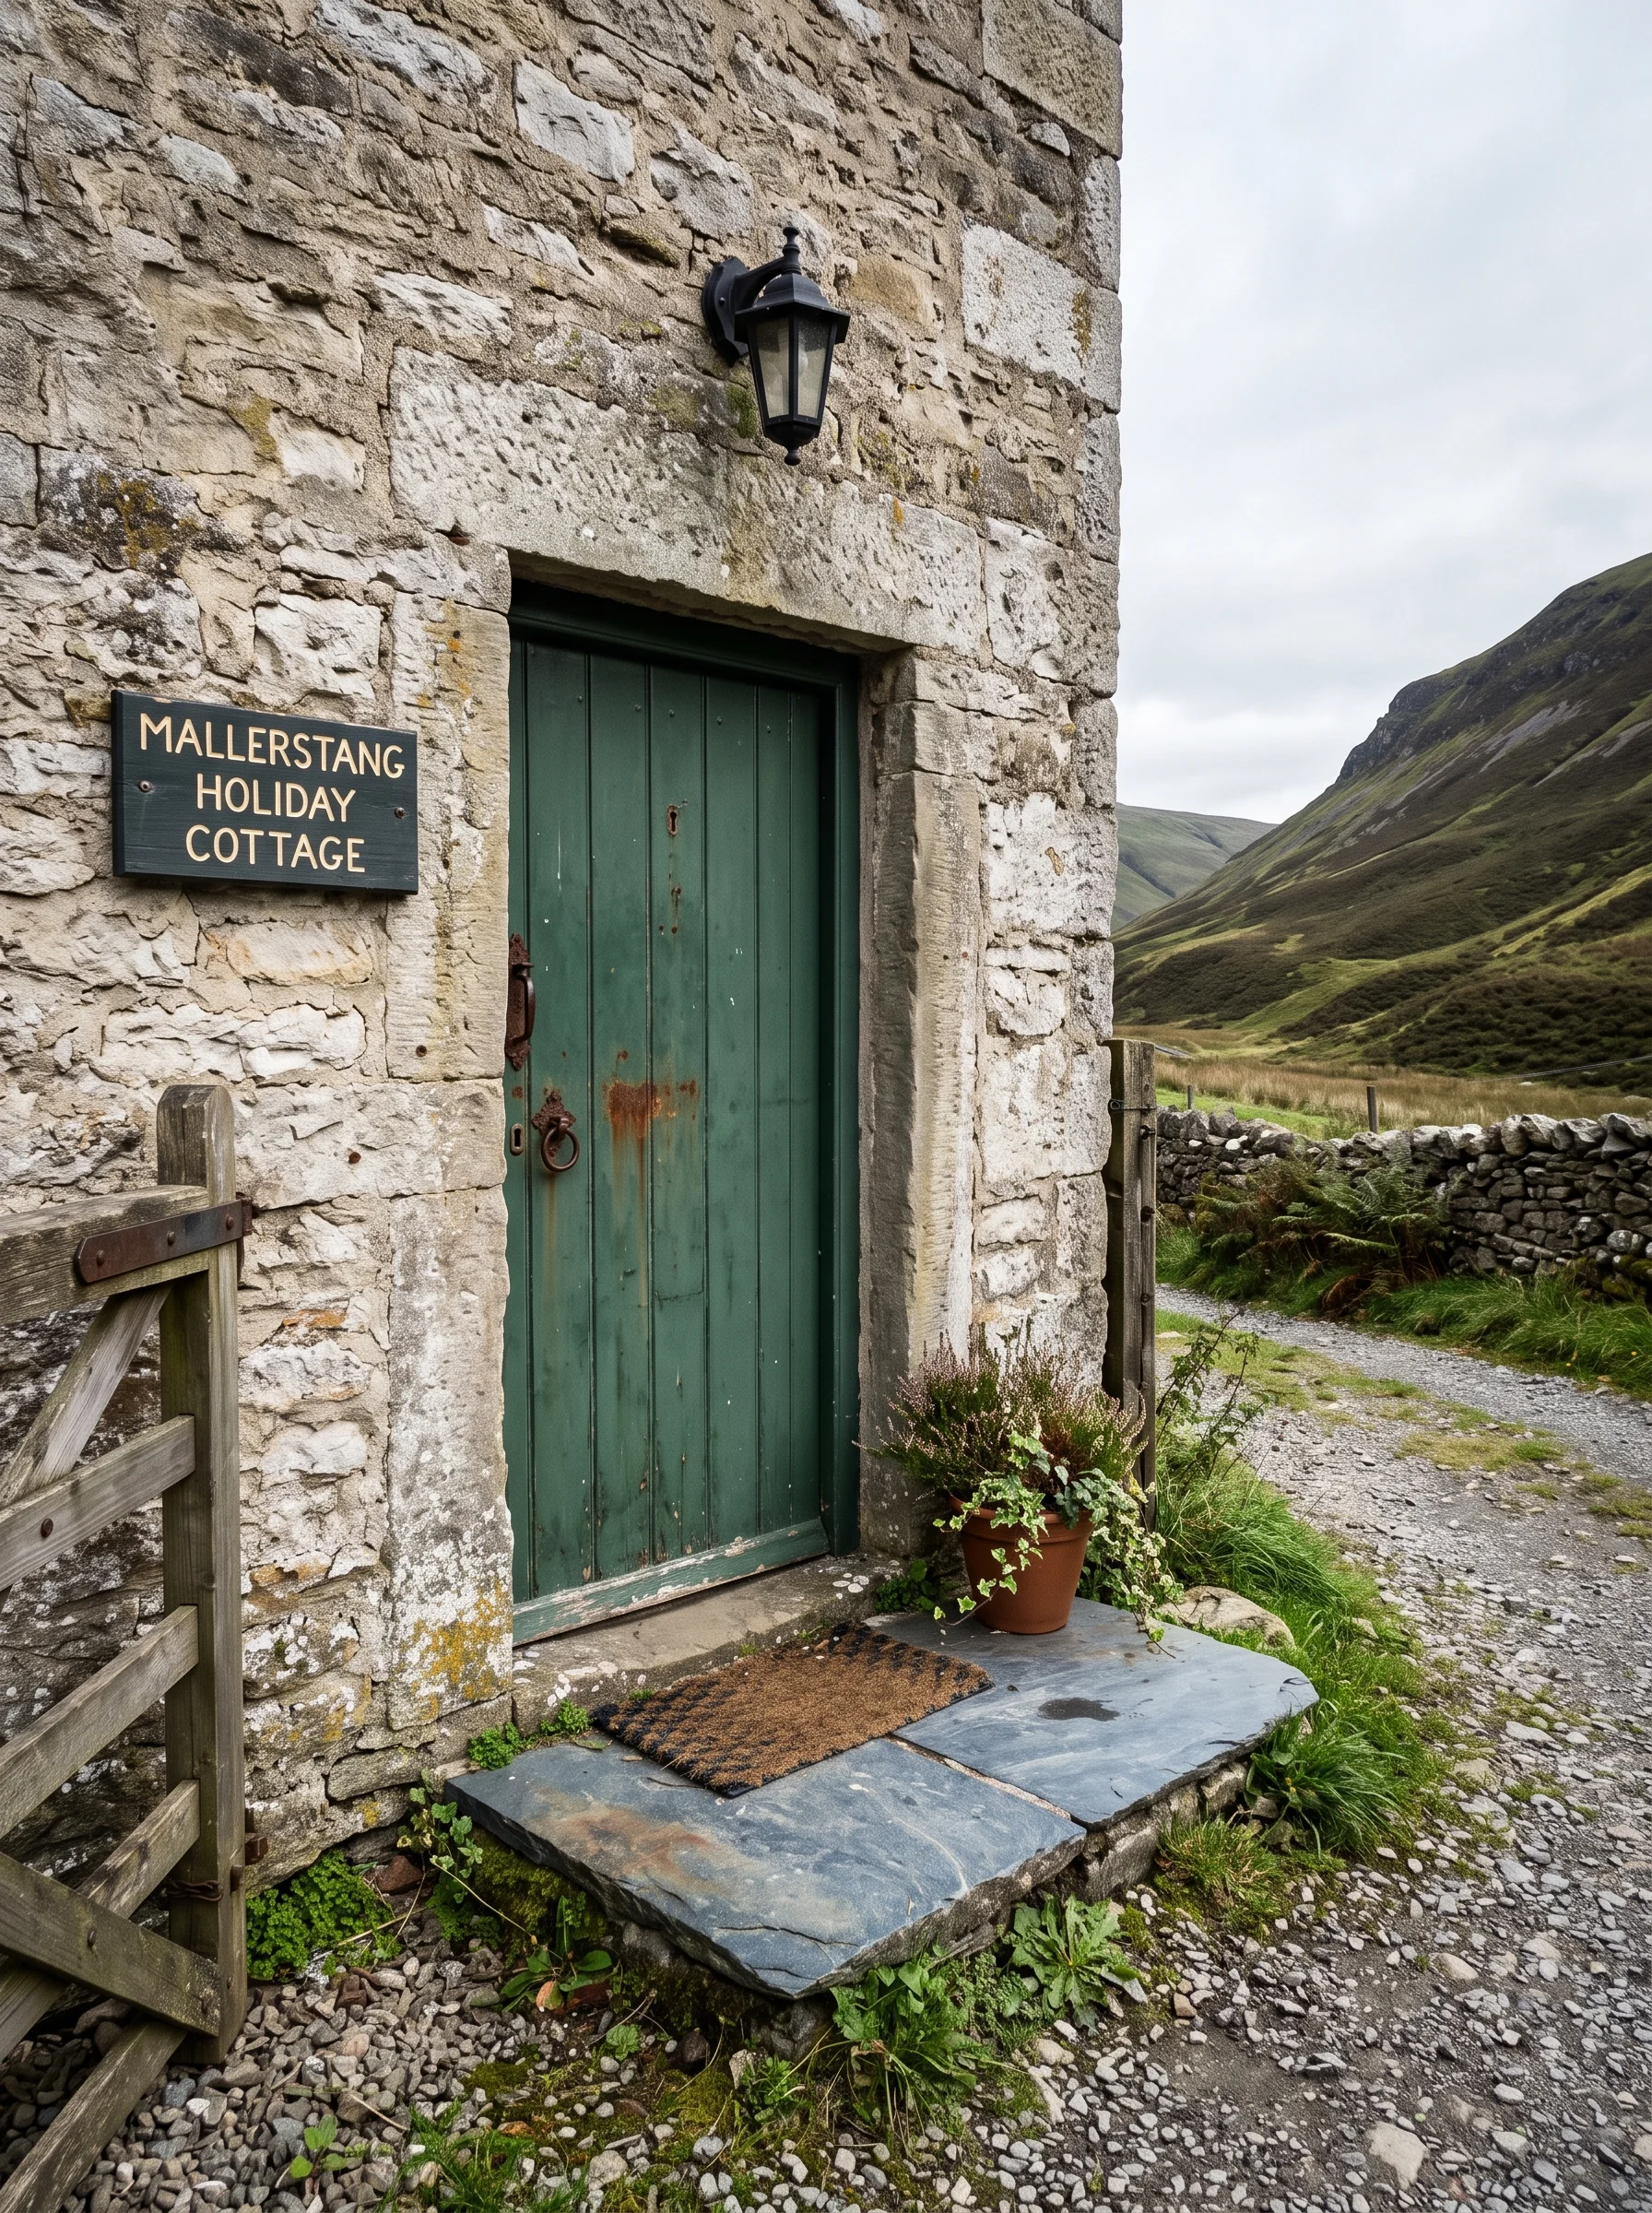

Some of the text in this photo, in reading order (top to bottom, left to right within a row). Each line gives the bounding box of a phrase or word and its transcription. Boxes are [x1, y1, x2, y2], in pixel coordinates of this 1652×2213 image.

[140, 713, 406, 779] MALLERSTANG
[196, 773, 357, 822] HOLIDAY
[185, 824, 366, 873] COTTAGE
